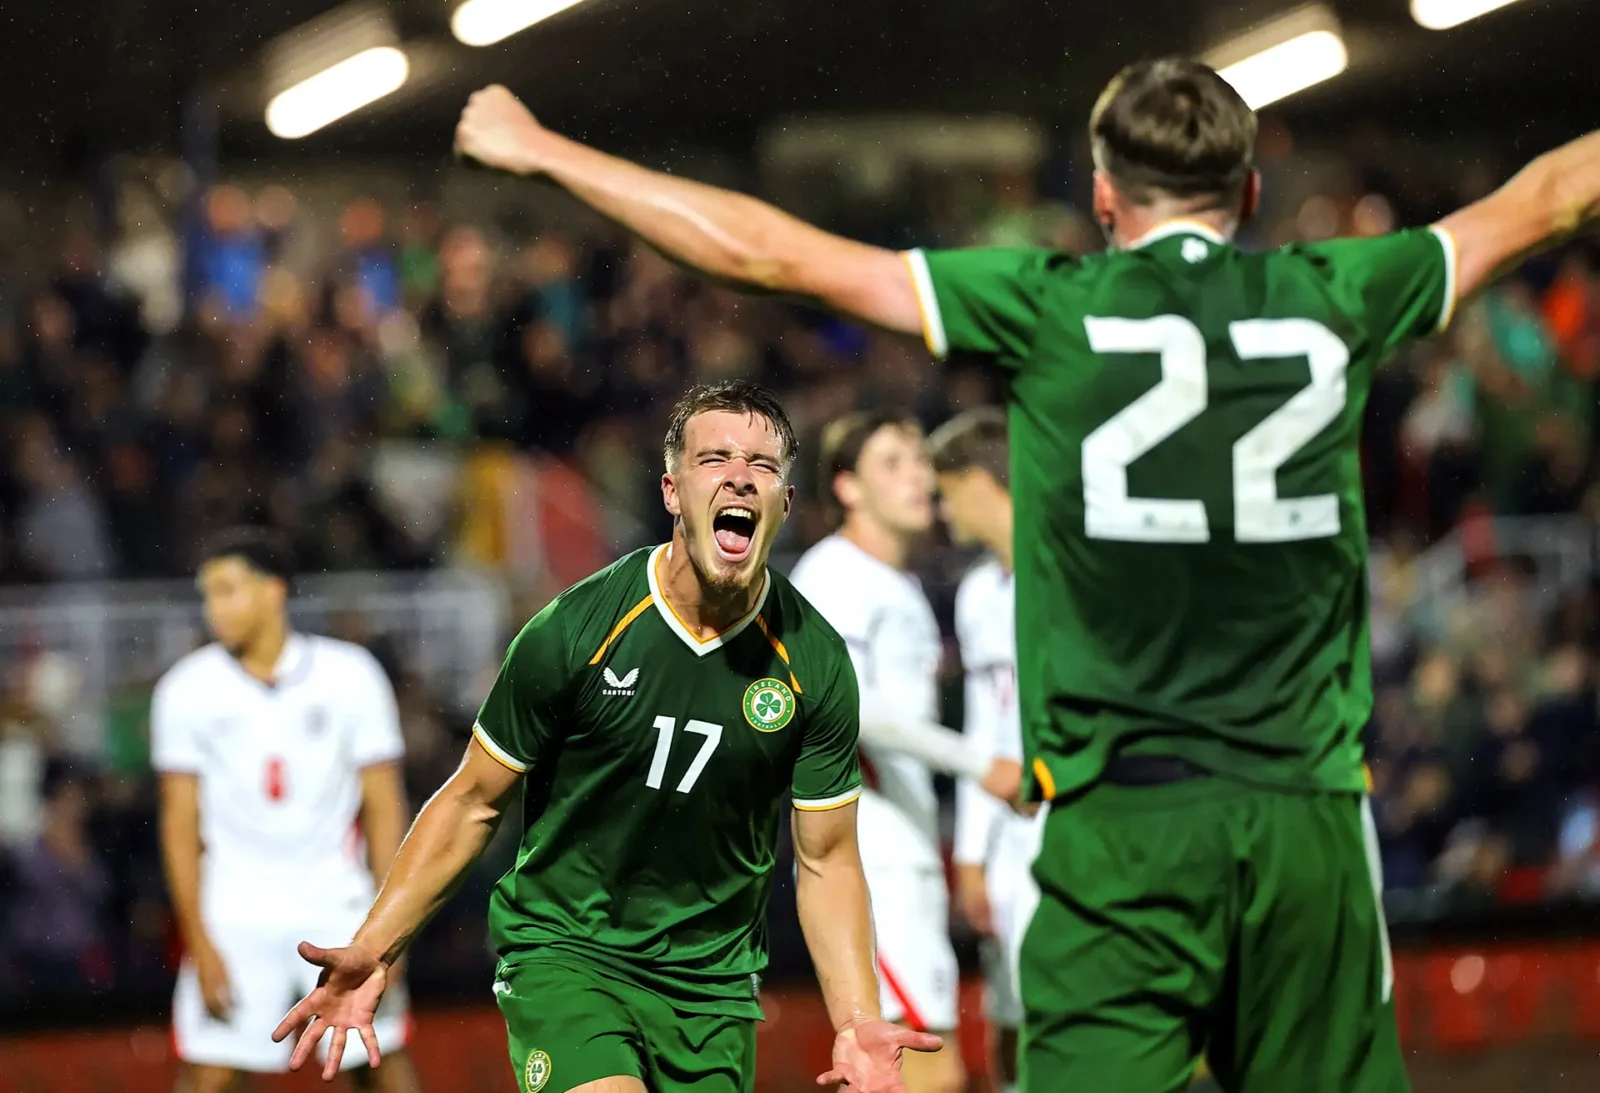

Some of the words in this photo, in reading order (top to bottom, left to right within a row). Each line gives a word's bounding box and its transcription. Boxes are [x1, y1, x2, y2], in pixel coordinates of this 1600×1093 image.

[1081, 314, 1350, 543] 22
[749, 681, 792, 702] IRELAND
[645, 715, 724, 794] 17
